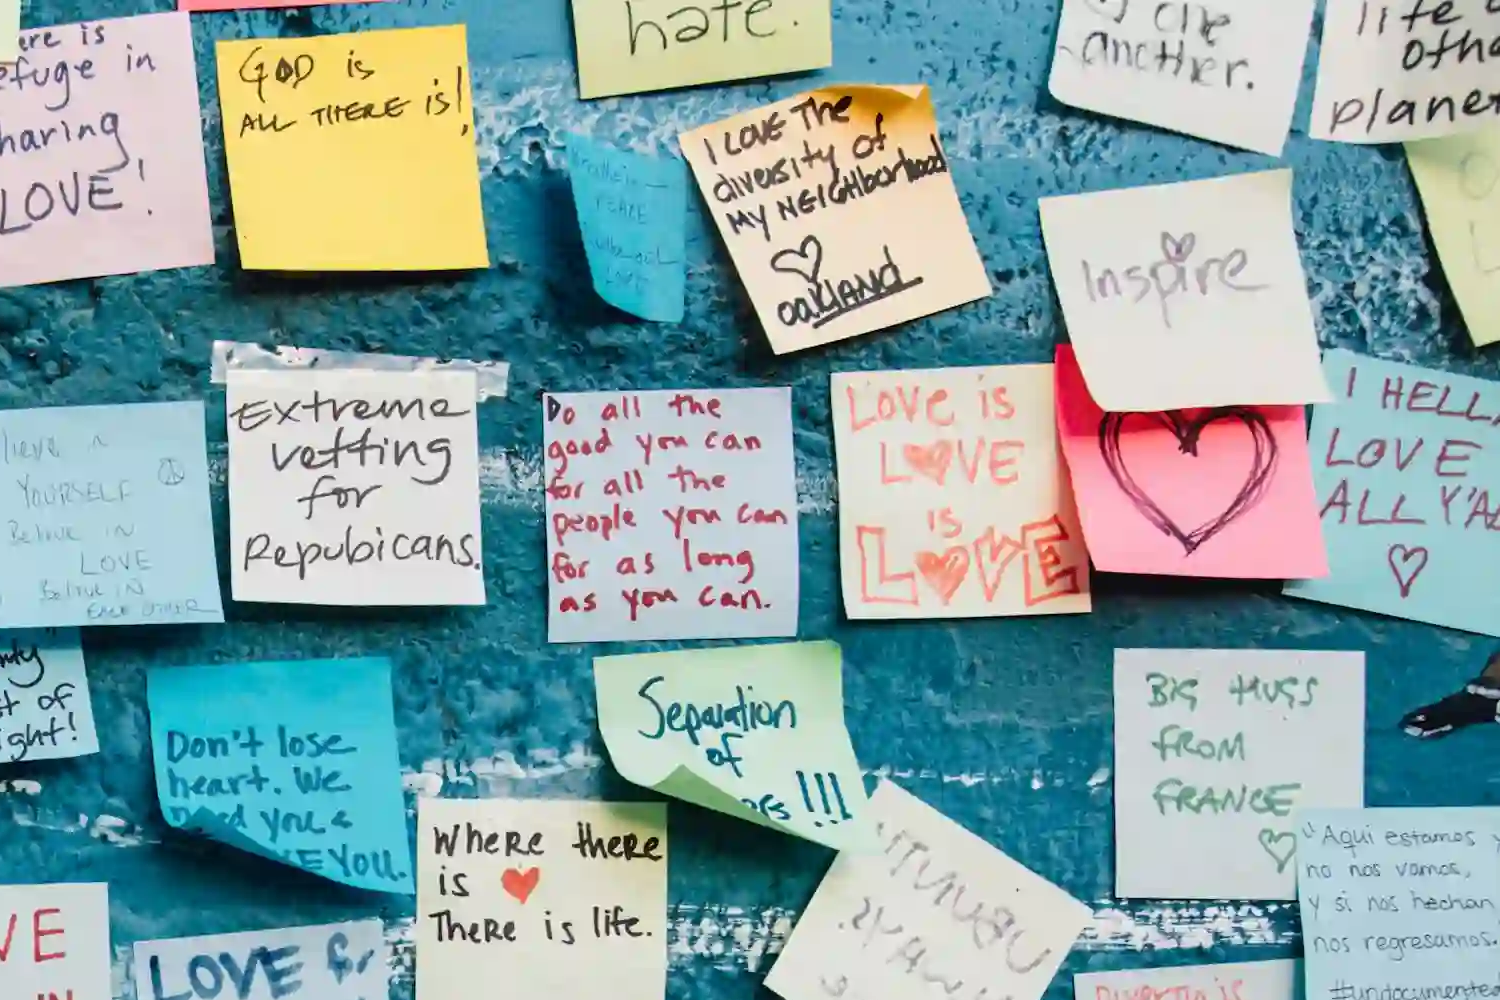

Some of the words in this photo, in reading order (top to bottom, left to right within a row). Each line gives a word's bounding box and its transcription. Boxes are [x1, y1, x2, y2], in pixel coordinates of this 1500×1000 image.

[81, 23, 105, 44] is
[626, 0, 798, 55] hate.
[126, 43, 156, 72] in
[346, 51, 376, 81] is
[240, 113, 297, 137] ALL
[311, 96, 410, 126] THERE
[852, 113, 888, 158] of
[1081, 233, 1270, 329] Inspire
[547, 395, 576, 425] Do
[601, 394, 642, 419] all
[669, 394, 721, 419] the
[271, 429, 453, 485] vetting
[547, 429, 613, 472] good
[635, 435, 687, 463] you
[706, 433, 761, 450] can
[1324, 427, 1482, 478] LOVE
[298, 475, 382, 519] for
[547, 475, 583, 500] for
[604, 470, 644, 496] all
[668, 466, 726, 492] the
[1319, 478, 1425, 526] ALL
[552, 505, 636, 546] people
[663, 505, 721, 538] you
[737, 504, 789, 525] can
[552, 552, 588, 582] for
[617, 555, 654, 574] as
[683, 540, 755, 580] long
[559, 593, 597, 612] as
[622, 588, 677, 621] you
[699, 588, 771, 609] can.
[38, 683, 75, 710] of
[638, 675, 798, 742] Separation
[1229, 674, 1320, 709] HUGS
[167, 730, 265, 762] Don't
[281, 725, 358, 753] lose
[706, 733, 744, 777] of
[1384, 826, 1476, 847] estamos
[438, 866, 470, 896] is
[1306, 862, 1333, 878] no
[1348, 860, 1382, 878] nos
[1365, 891, 1399, 913] nos
[546, 910, 574, 944] is
[1313, 933, 1351, 953] nos
